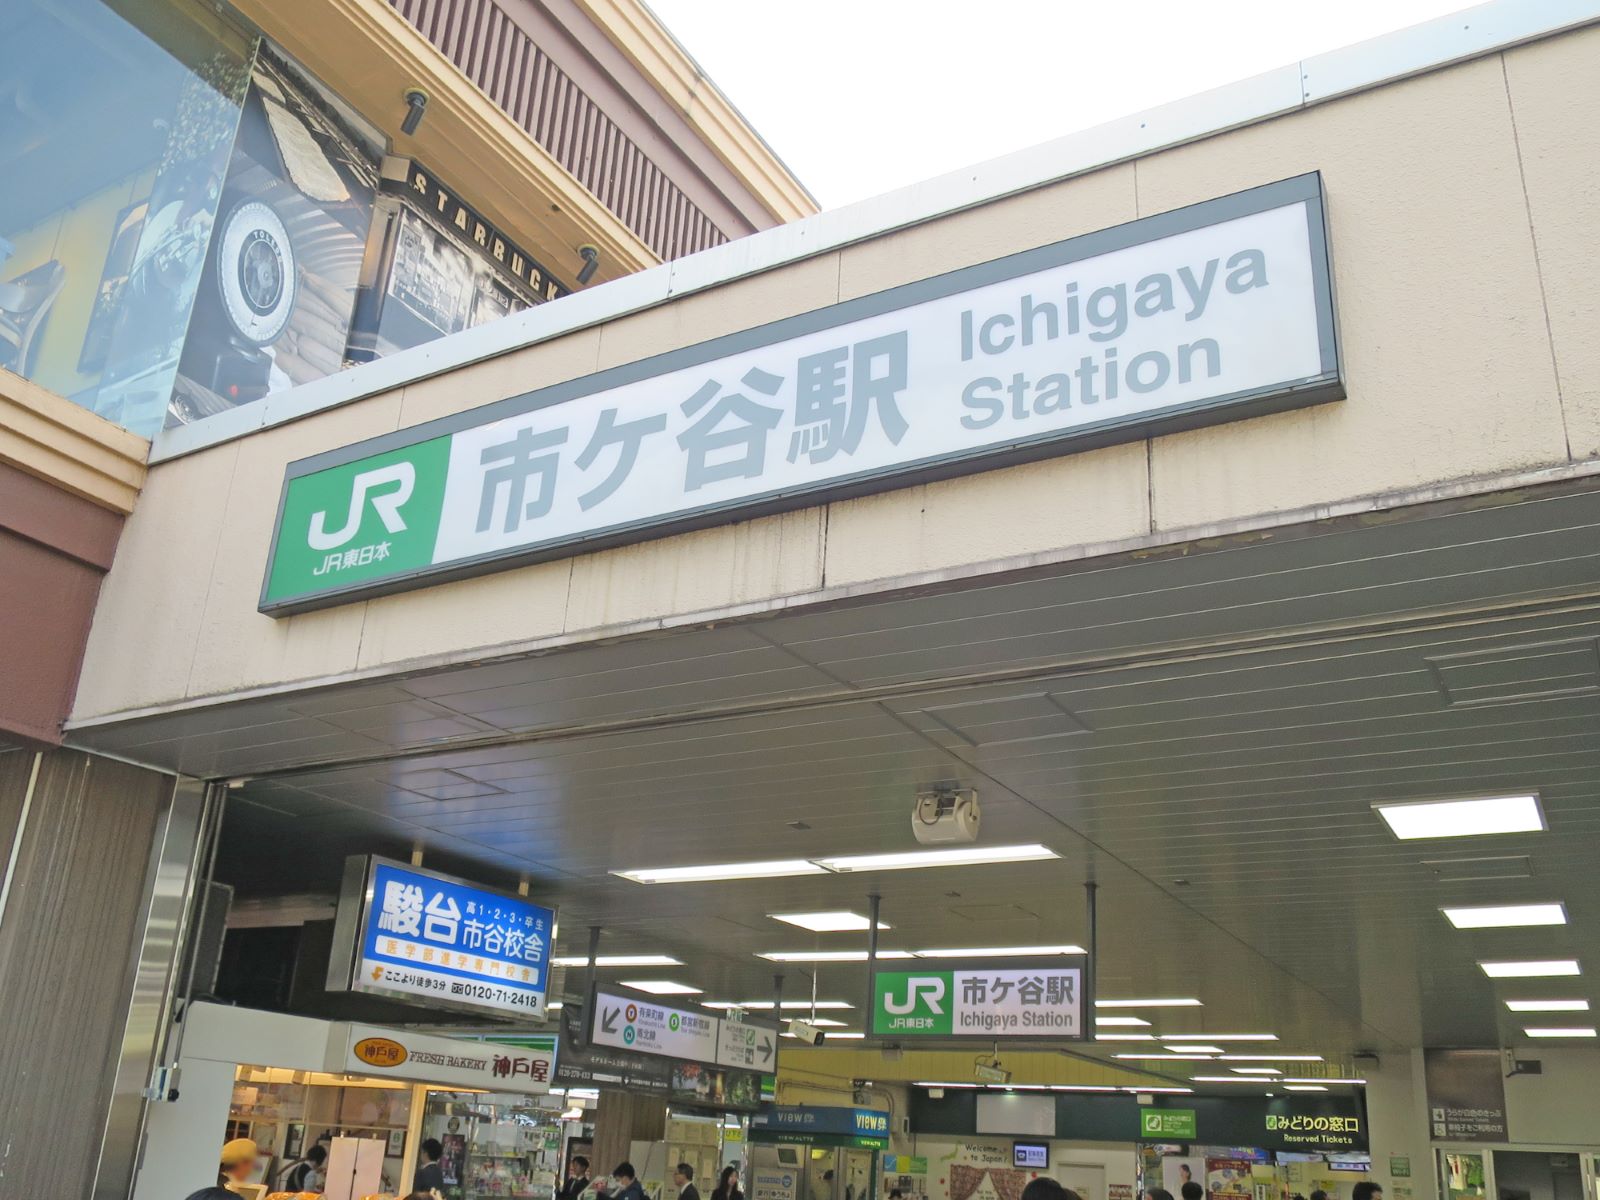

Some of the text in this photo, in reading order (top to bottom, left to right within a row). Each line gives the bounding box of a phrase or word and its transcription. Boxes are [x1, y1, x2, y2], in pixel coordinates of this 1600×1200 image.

[413, 172, 558, 301] STARBUCK
[961, 249, 1269, 362] Ichigaya
[960, 338, 1221, 430] Station
[307, 461, 416, 550] JR
[313, 541, 392, 576] JR東日本
[378, 880, 461, 945] 駿台
[463, 918, 544, 962] 市谷校舎
[385, 970, 446, 990] ここより徒歩3分
[884, 977, 945, 1015] JR
[888, 1018, 934, 1029] JR東日本
[961, 1011, 1073, 1030] Ichigaya Station
[409, 1051, 487, 1071] FRESH BAKERY
[1278, 1115, 1359, 1132] みどりの窓口
[1284, 1133, 1353, 1144] Reserved Tickets
[965, 1143, 998, 1153] Welcome
